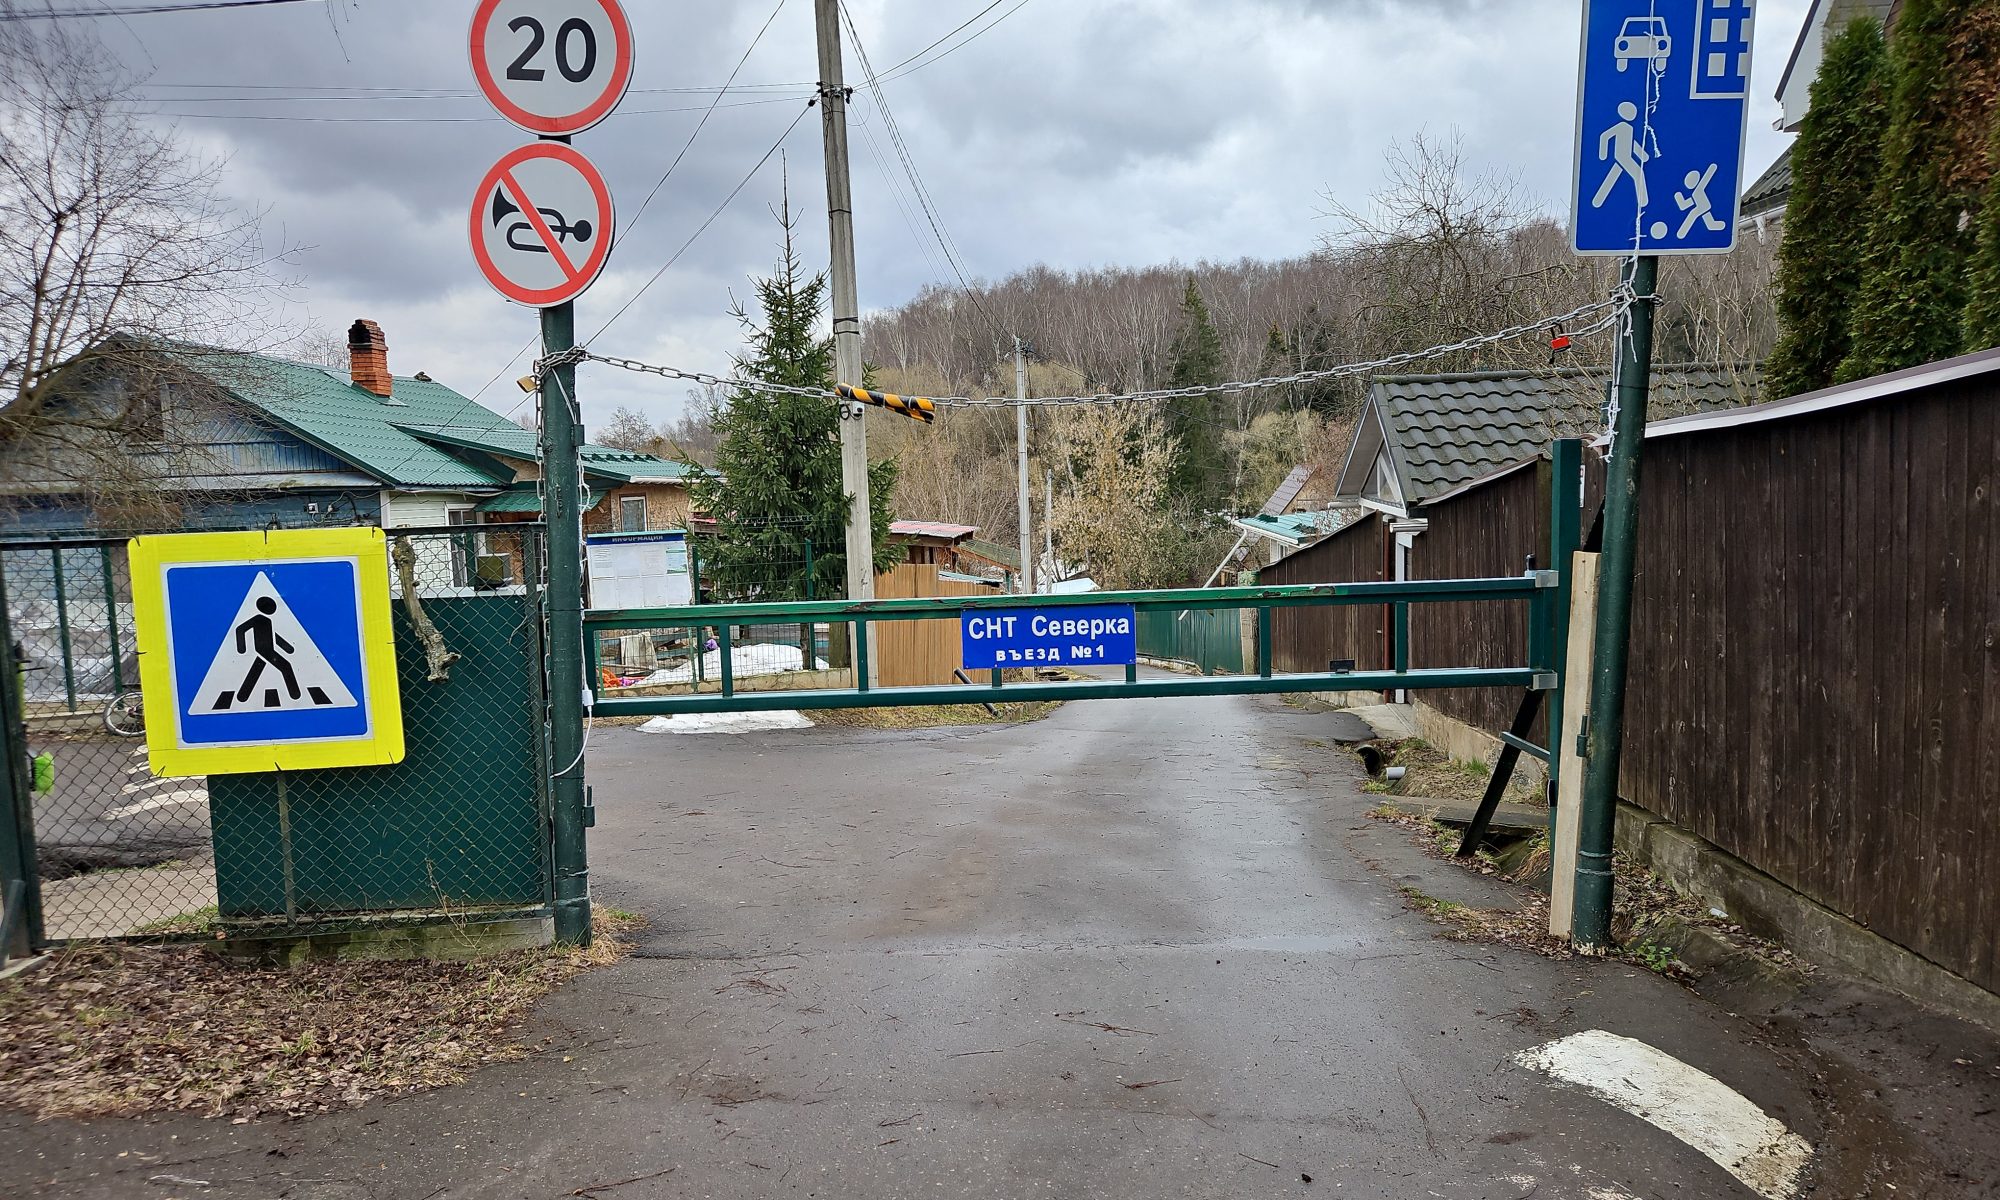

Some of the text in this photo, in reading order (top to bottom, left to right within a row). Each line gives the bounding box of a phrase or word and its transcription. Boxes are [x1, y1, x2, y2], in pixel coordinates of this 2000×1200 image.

[506, 15, 597, 83] 20
[968, 615, 1130, 640] СНТ Северка
[995, 648, 1060, 662] ВЪЕЗД
